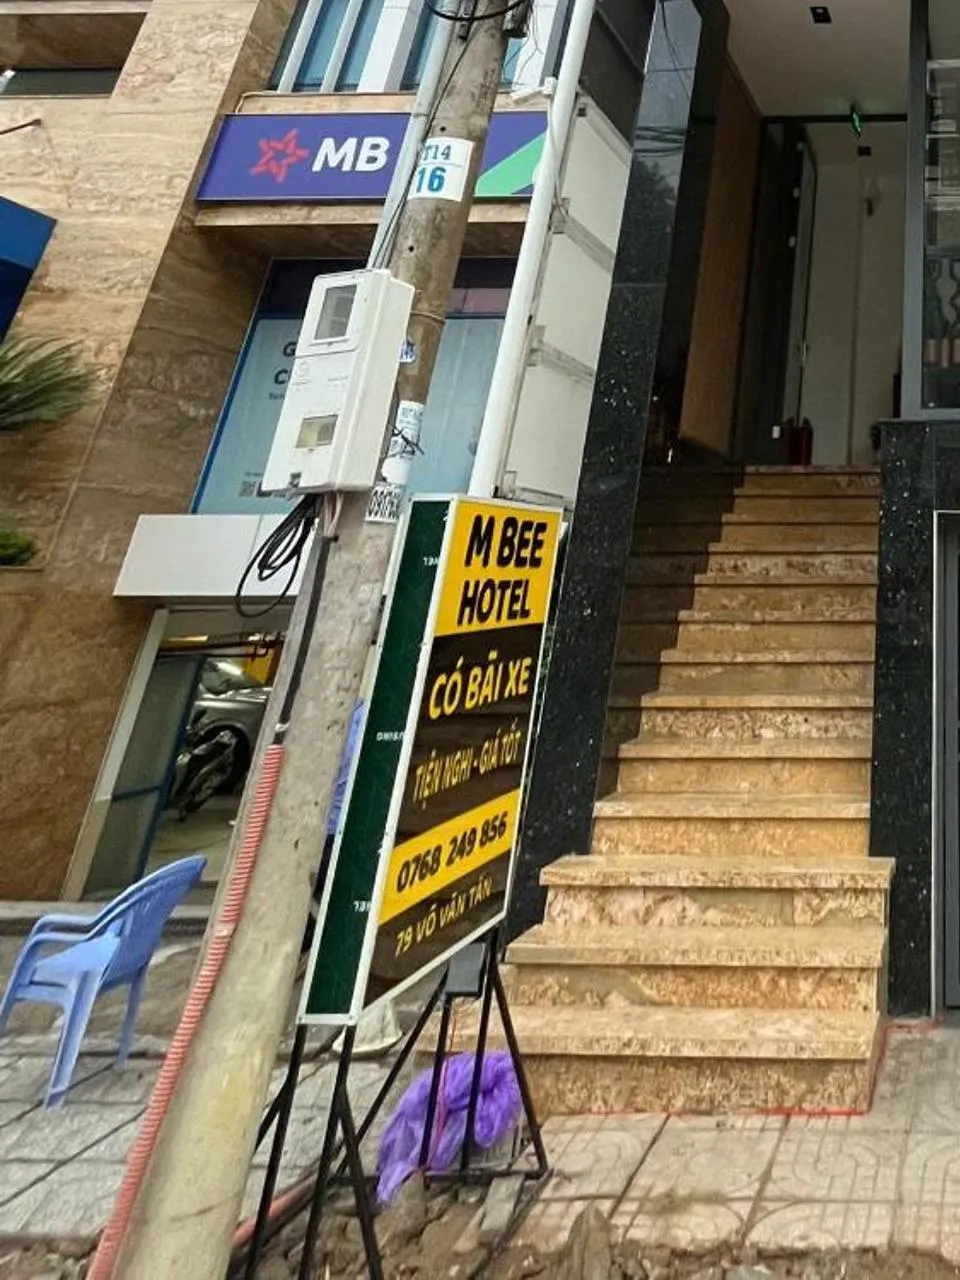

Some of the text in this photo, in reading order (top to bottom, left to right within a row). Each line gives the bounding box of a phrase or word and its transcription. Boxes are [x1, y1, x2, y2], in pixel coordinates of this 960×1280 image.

[312, 136, 390, 173] MB
[416, 166, 447, 193] 16
[456, 577, 531, 627] HOTEL
[429, 650, 532, 720] CÓ BÃI XE
[396, 843, 443, 893] 0768
[445, 827, 478, 867] 249
[395, 925, 413, 958] 79
